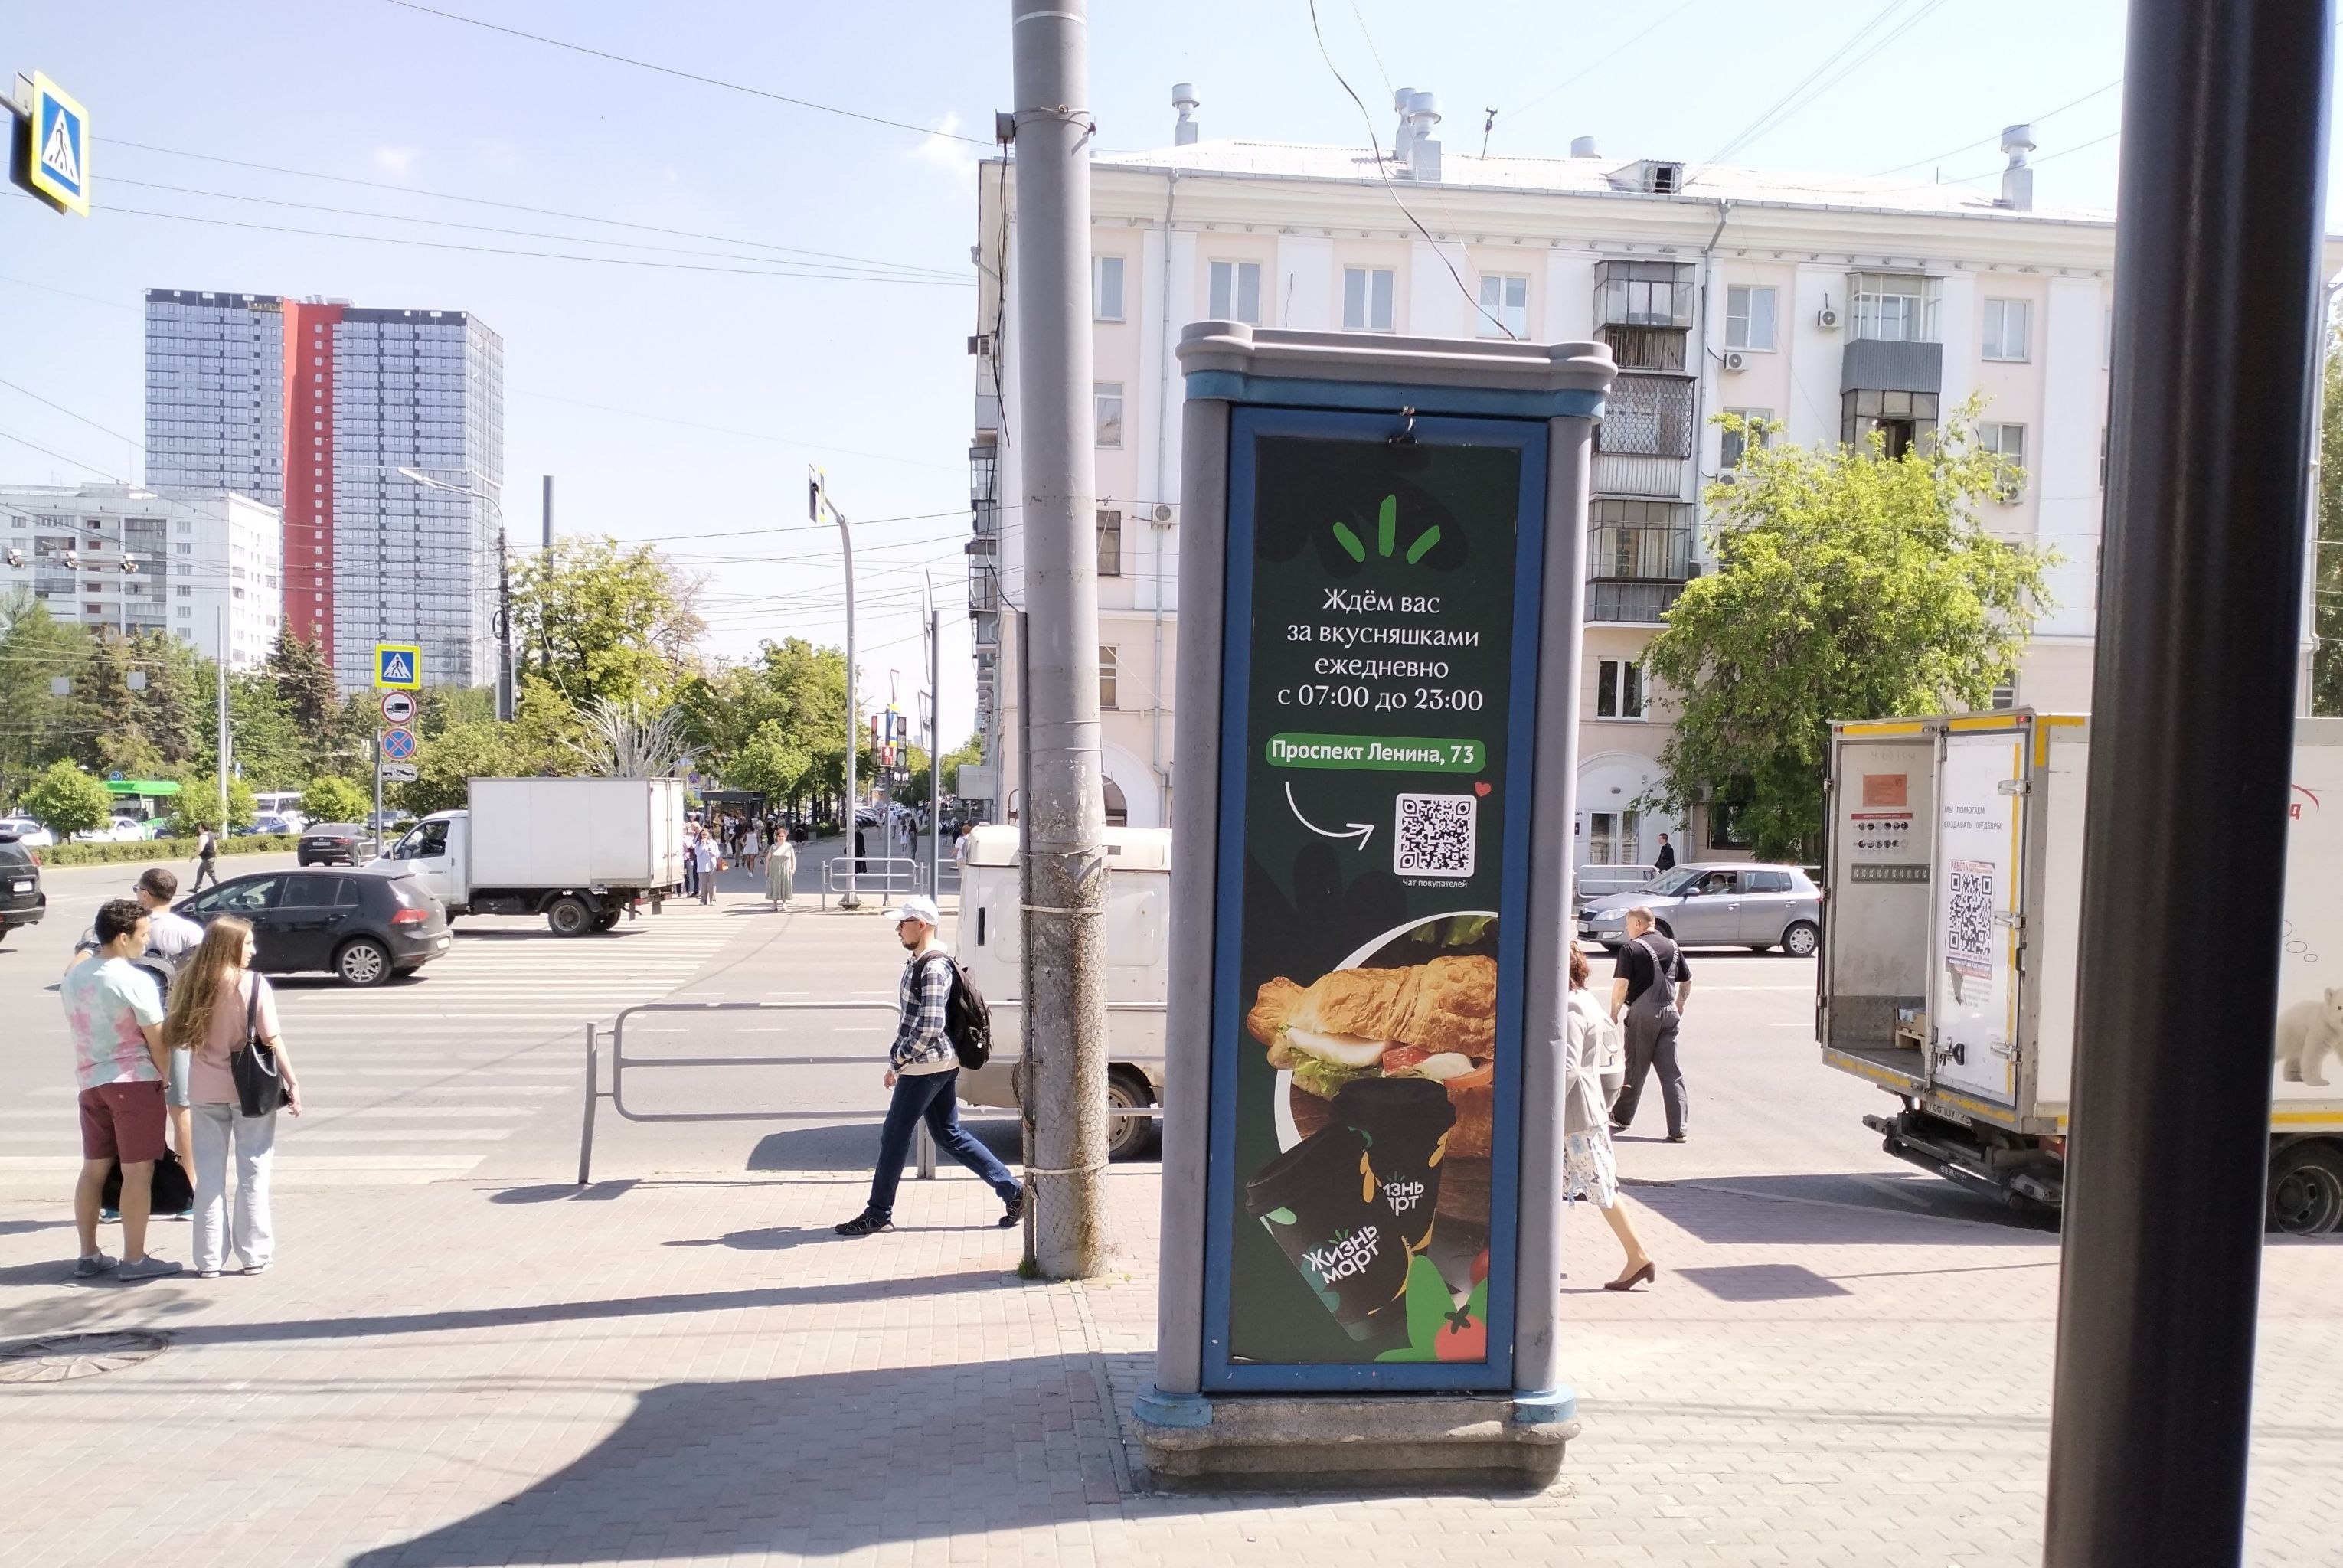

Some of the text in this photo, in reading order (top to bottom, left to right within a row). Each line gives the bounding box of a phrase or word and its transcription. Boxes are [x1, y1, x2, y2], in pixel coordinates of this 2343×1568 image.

[1322, 588, 1440, 615] Ждём вас
[1286, 624, 1479, 649] за вкусняшками
[1315, 658, 1449, 681] ежедневно
[1277, 684, 1483, 712] с 07:00 до 23:00
[1272, 740, 1474, 766] Проспект Ленина, 73
[1956, 806, 1985, 815] ПОМОГАЕМ
[1402, 878, 1468, 889] Чат покупателей
